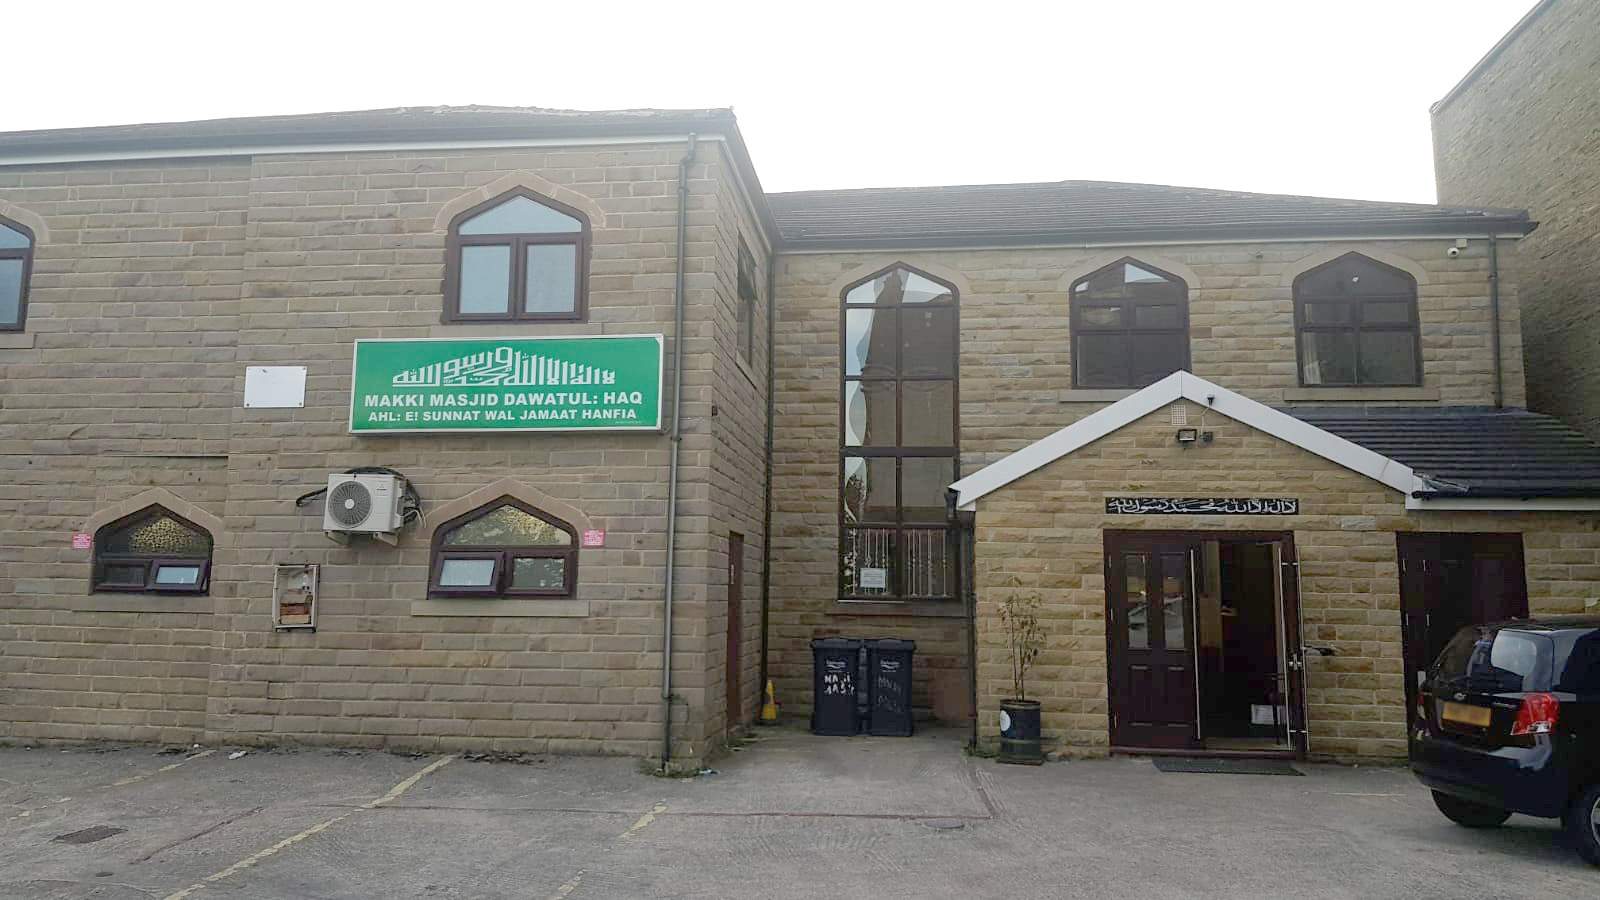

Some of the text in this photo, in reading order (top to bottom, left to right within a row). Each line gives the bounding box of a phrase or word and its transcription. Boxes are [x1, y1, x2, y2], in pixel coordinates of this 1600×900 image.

[364, 391, 642, 407] MAKKI MASJID DAWATUL: HAQ
[368, 411, 401, 422] AHL:
[423, 410, 480, 421] SUNNAT
[484, 410, 516, 421] WAL
[519, 409, 578, 420] JAMAAT
[582, 408, 637, 420] HANFIA
